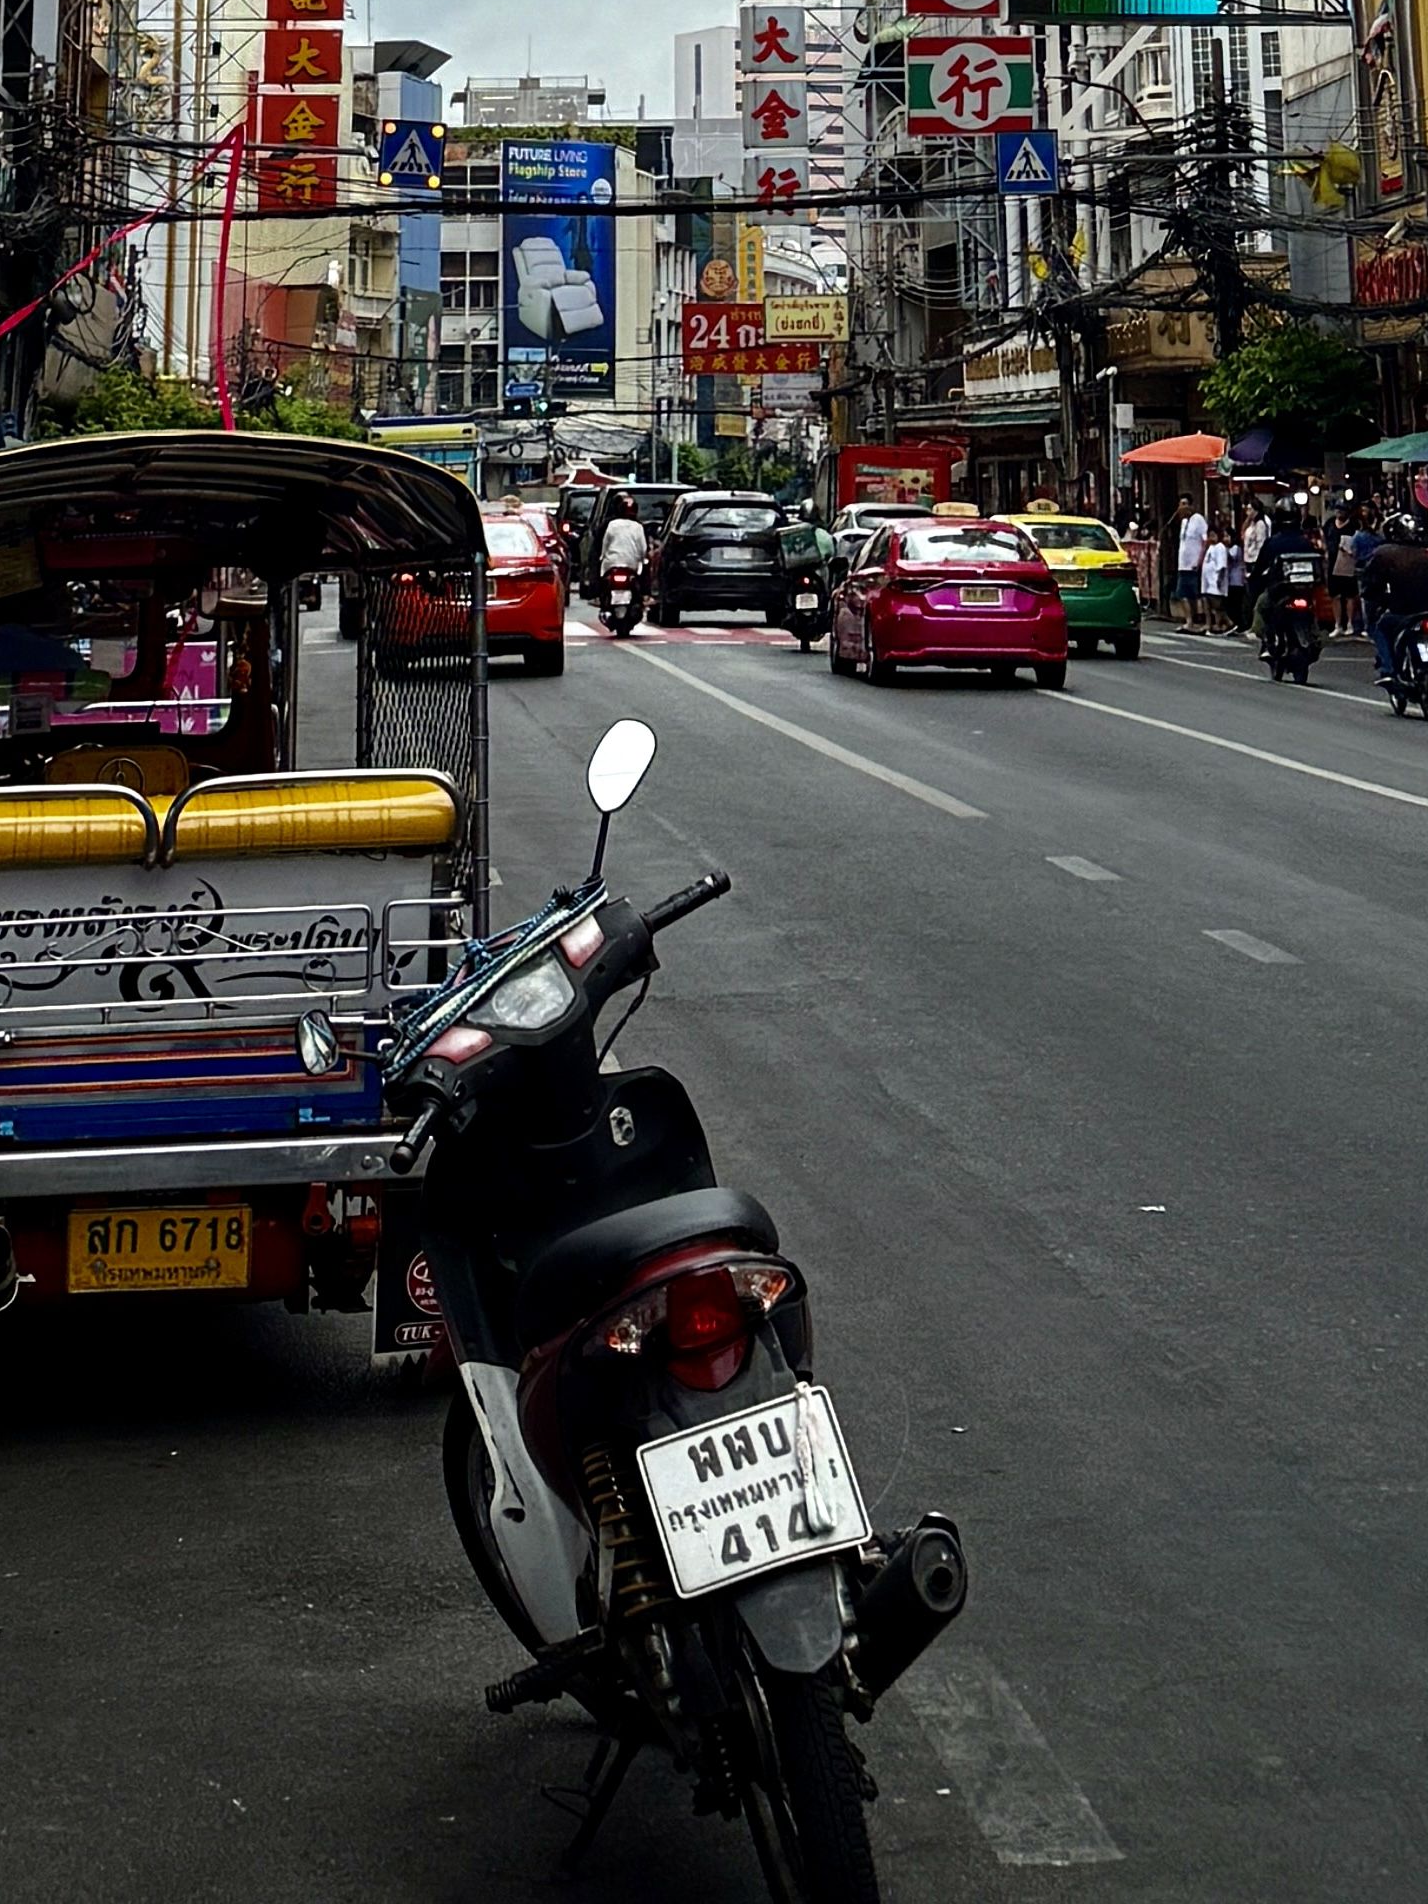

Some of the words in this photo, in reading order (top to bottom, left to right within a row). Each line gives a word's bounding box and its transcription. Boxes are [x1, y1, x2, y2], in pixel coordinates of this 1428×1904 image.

[508, 147, 552, 163] FUTURE
[508, 162, 556, 181] Flagship
[557, 164, 588, 179] Store
[688, 313, 731, 350] 24
[159, 1216, 244, 1253] 6718
